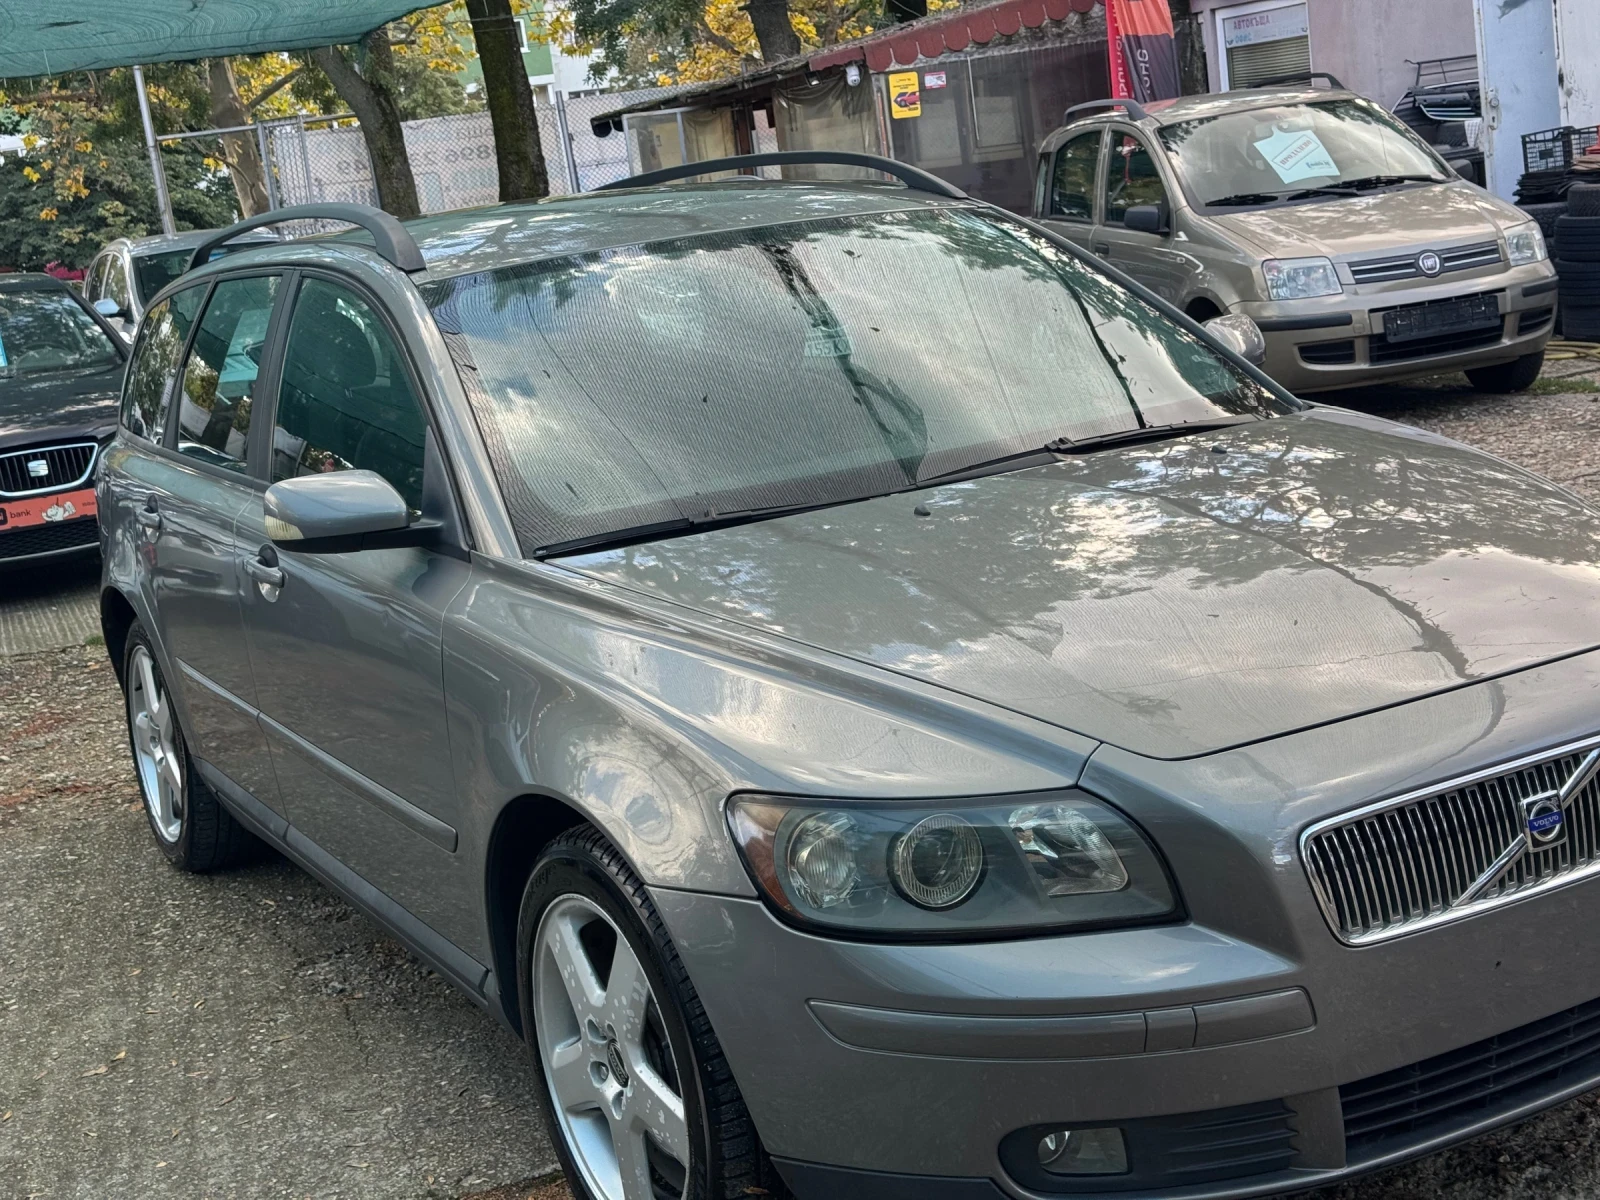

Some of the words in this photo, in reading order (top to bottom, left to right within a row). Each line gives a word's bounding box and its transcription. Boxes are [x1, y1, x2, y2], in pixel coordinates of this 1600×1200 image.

[1233, 14, 1270, 30] АВТОКЪЩА
[10, 509, 31, 519] bank
[1533, 815, 1559, 827] VOLVO
